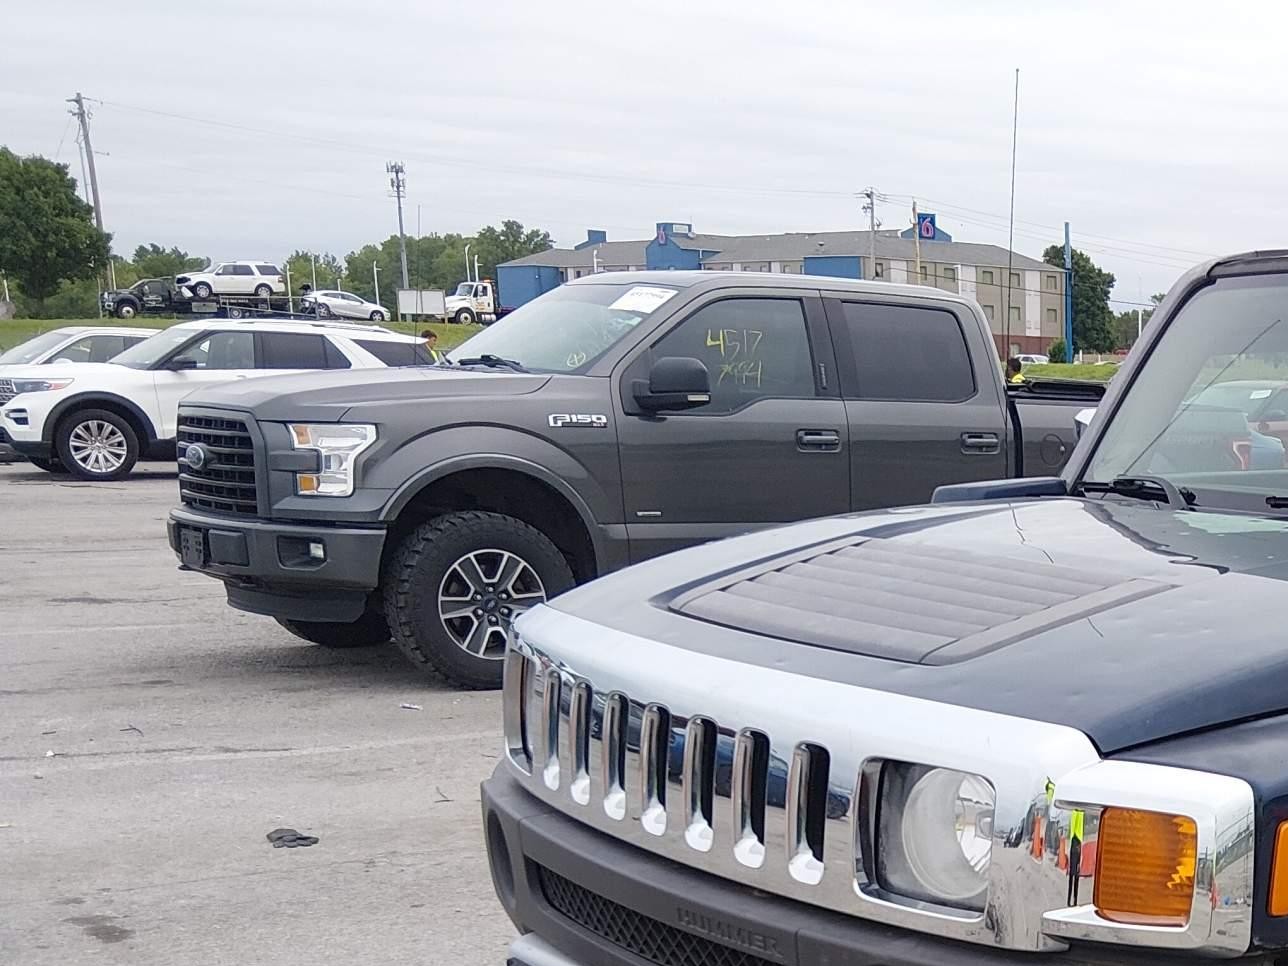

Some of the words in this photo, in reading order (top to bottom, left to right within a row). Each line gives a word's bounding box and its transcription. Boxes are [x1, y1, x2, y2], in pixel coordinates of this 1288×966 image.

[921, 217, 934, 239] 6
[707, 328, 762, 360] 4517
[677, 906, 785, 960] HUMMER
